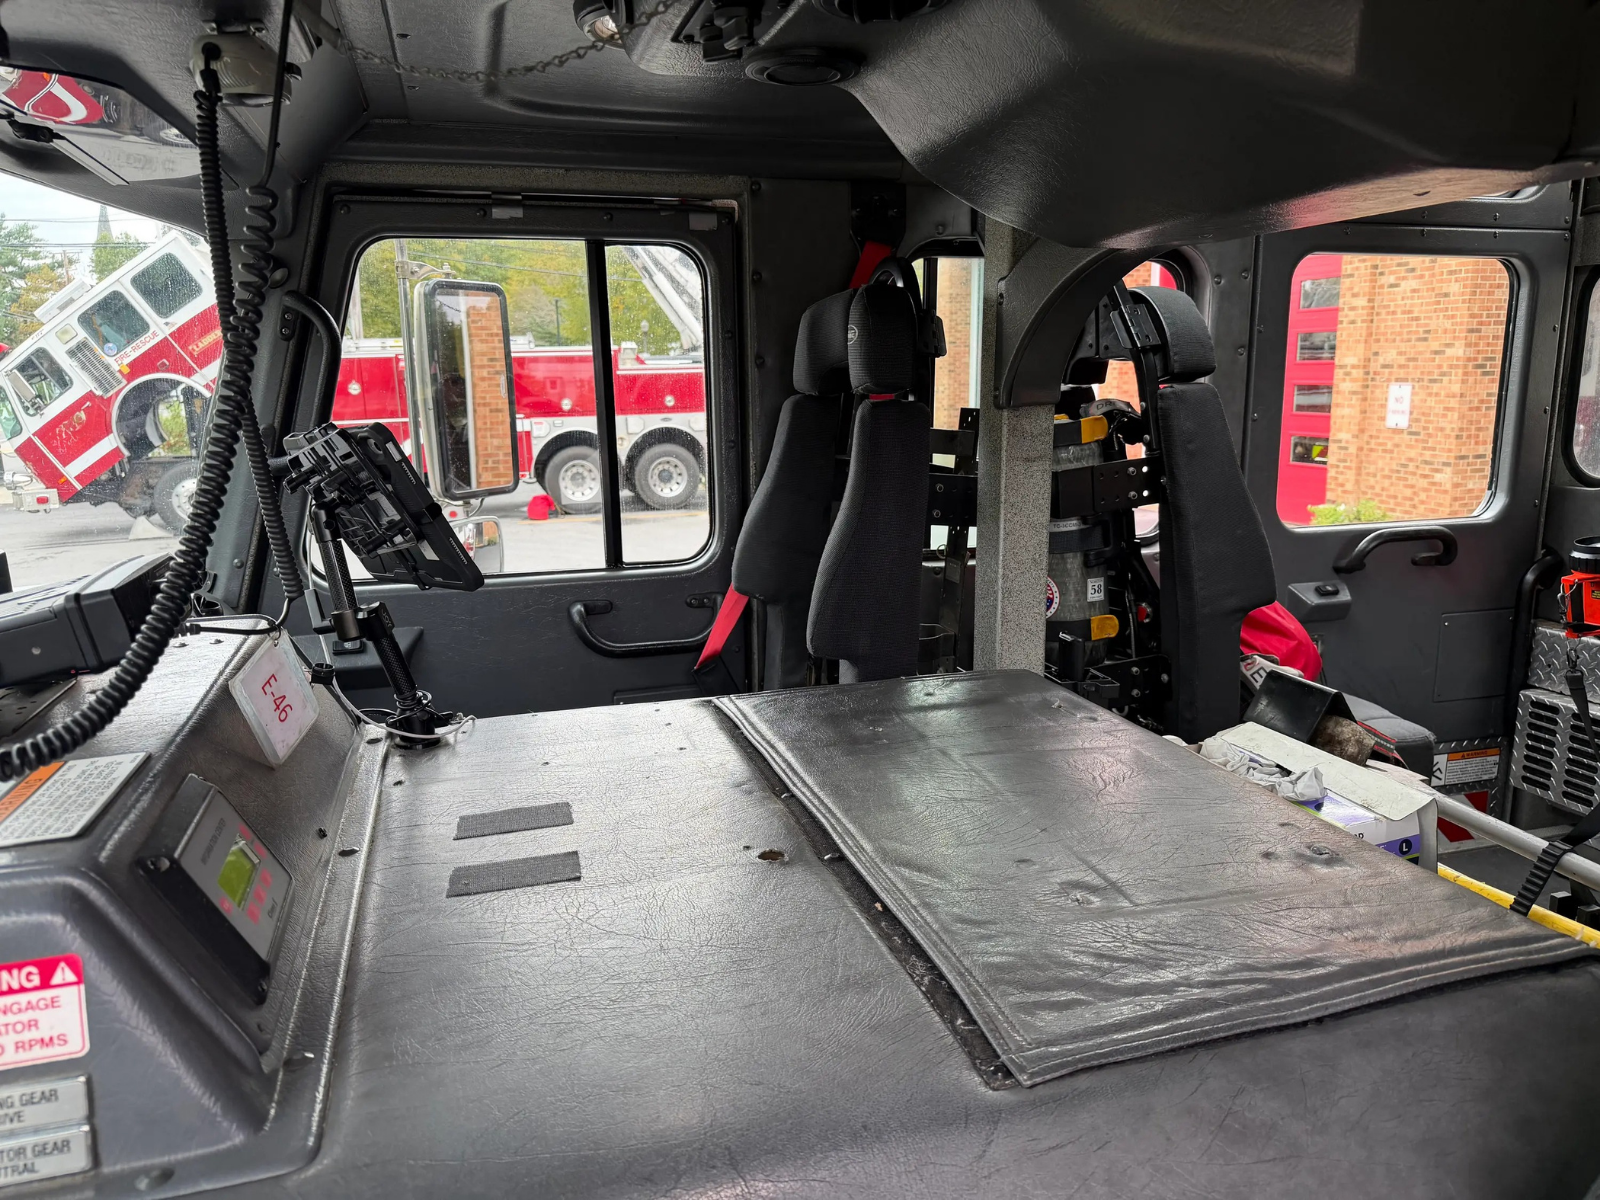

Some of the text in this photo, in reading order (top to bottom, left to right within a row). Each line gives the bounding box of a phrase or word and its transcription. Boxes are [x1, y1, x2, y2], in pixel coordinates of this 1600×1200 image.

[114, 330, 159, 365] FIRE-RESCUE
[1090, 583, 1102, 595] 58
[261, 673, 293, 723] E-46
[0, 1019, 39, 1036] TOR
[15, 1033, 68, 1054] RPMS
[19, 1088, 59, 1107] GEAR
[31, 1140, 71, 1157] GEAR
